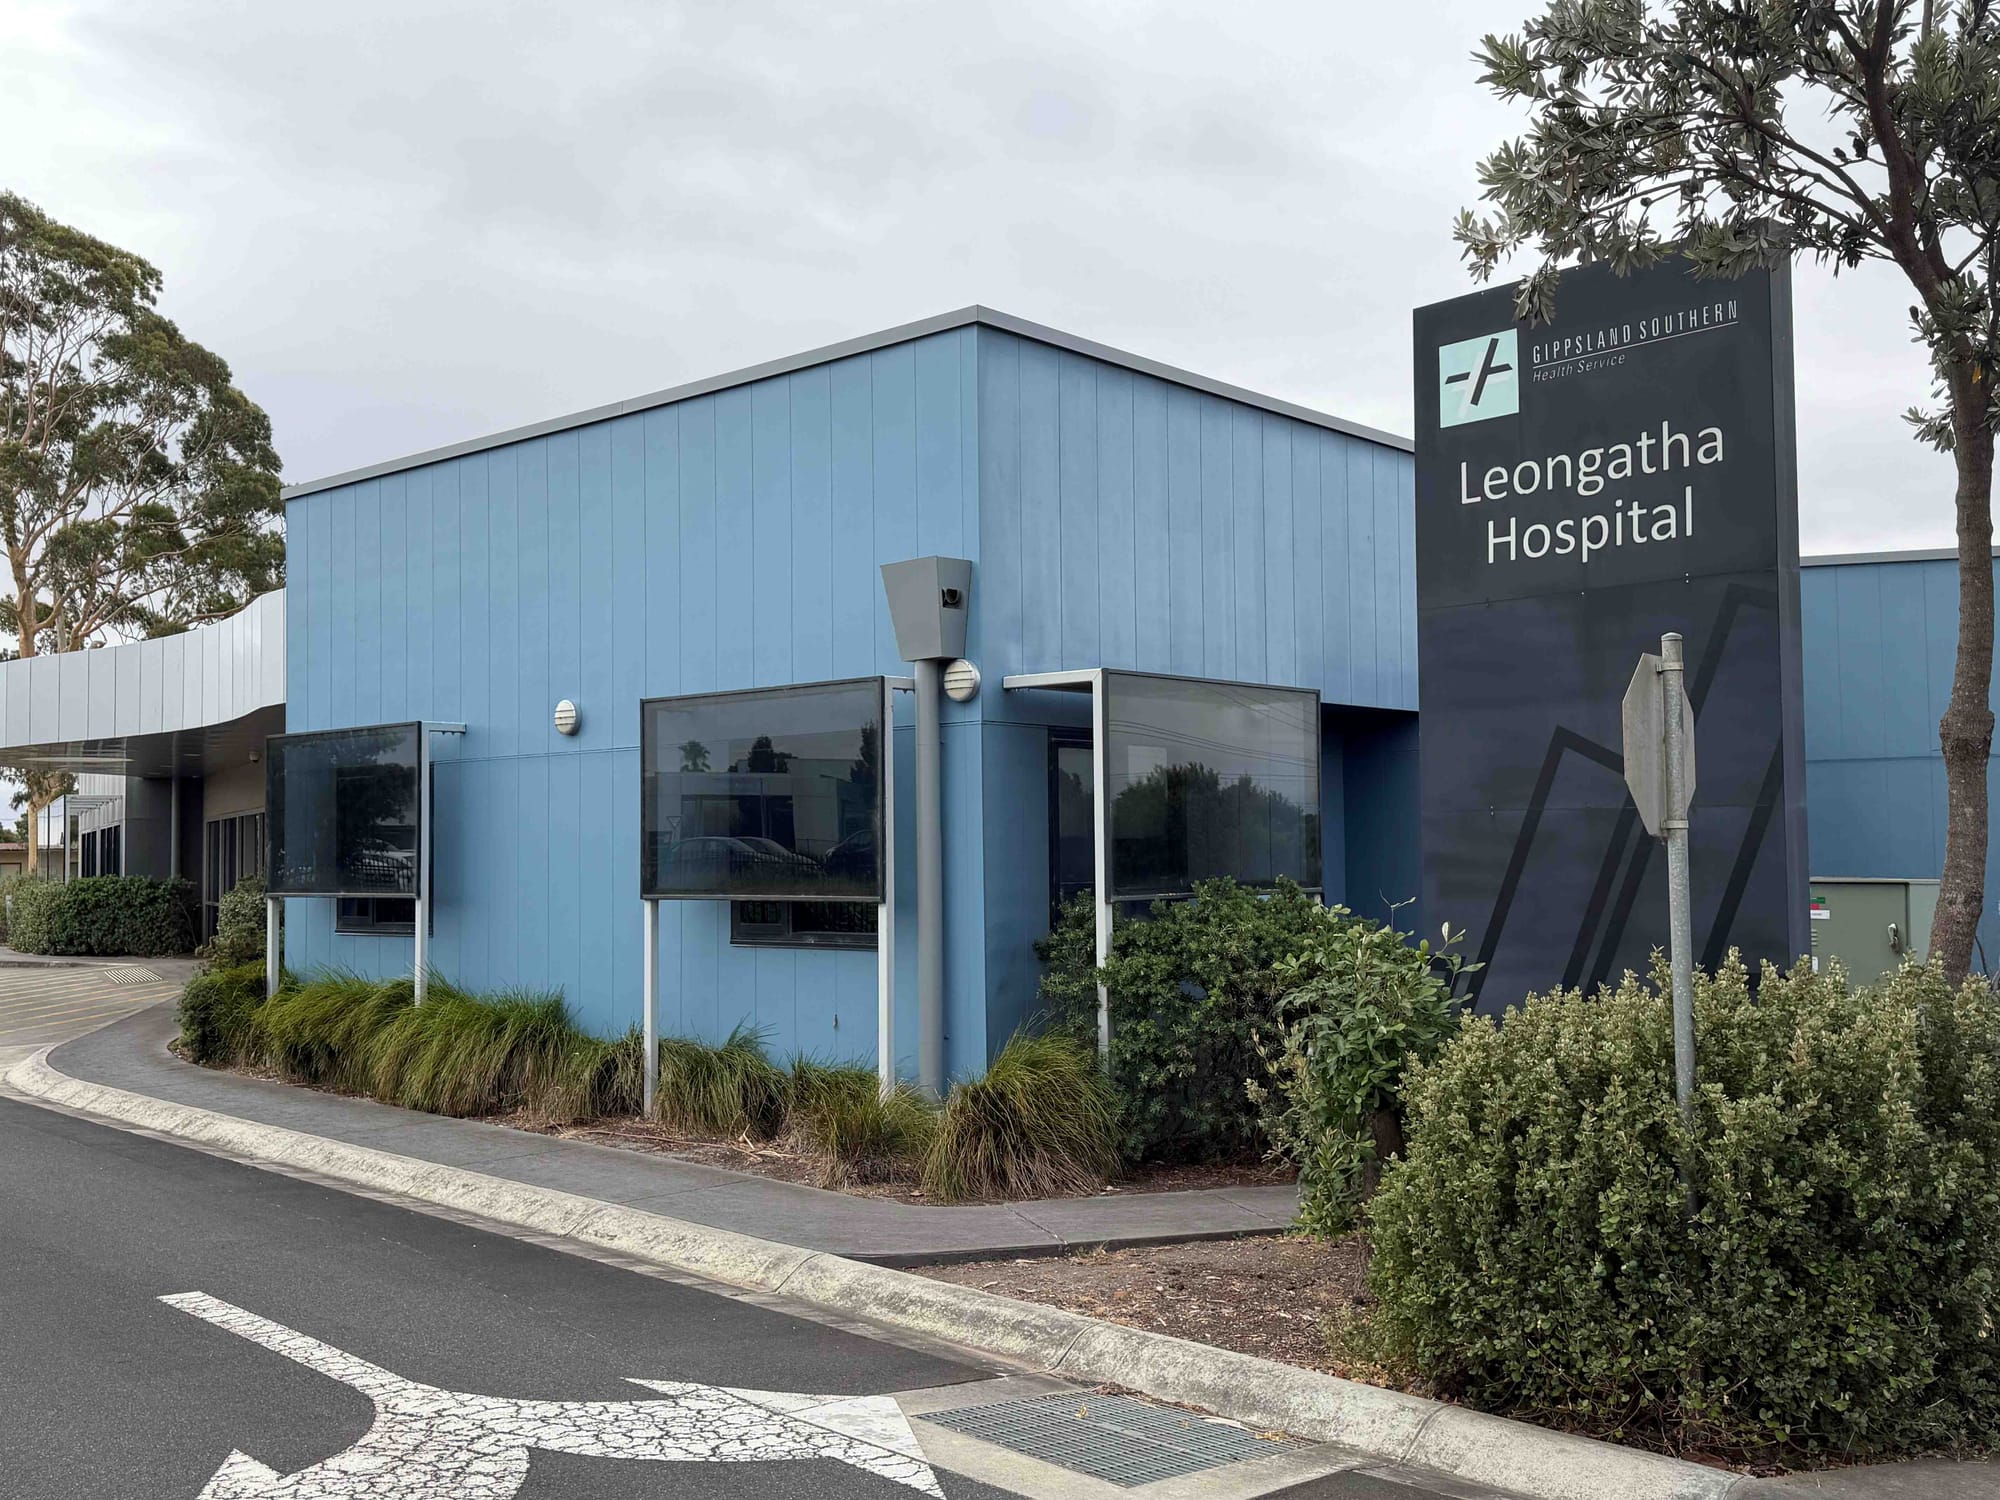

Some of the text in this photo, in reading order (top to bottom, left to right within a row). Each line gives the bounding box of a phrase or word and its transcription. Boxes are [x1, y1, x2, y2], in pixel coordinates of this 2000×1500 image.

[1532, 300, 1739, 364] GIPPSLAND SOUTHERN
[1532, 353, 1626, 383] Health Service
[1460, 420, 1724, 505] Leongatha
[1487, 485, 1694, 564] Hospital
